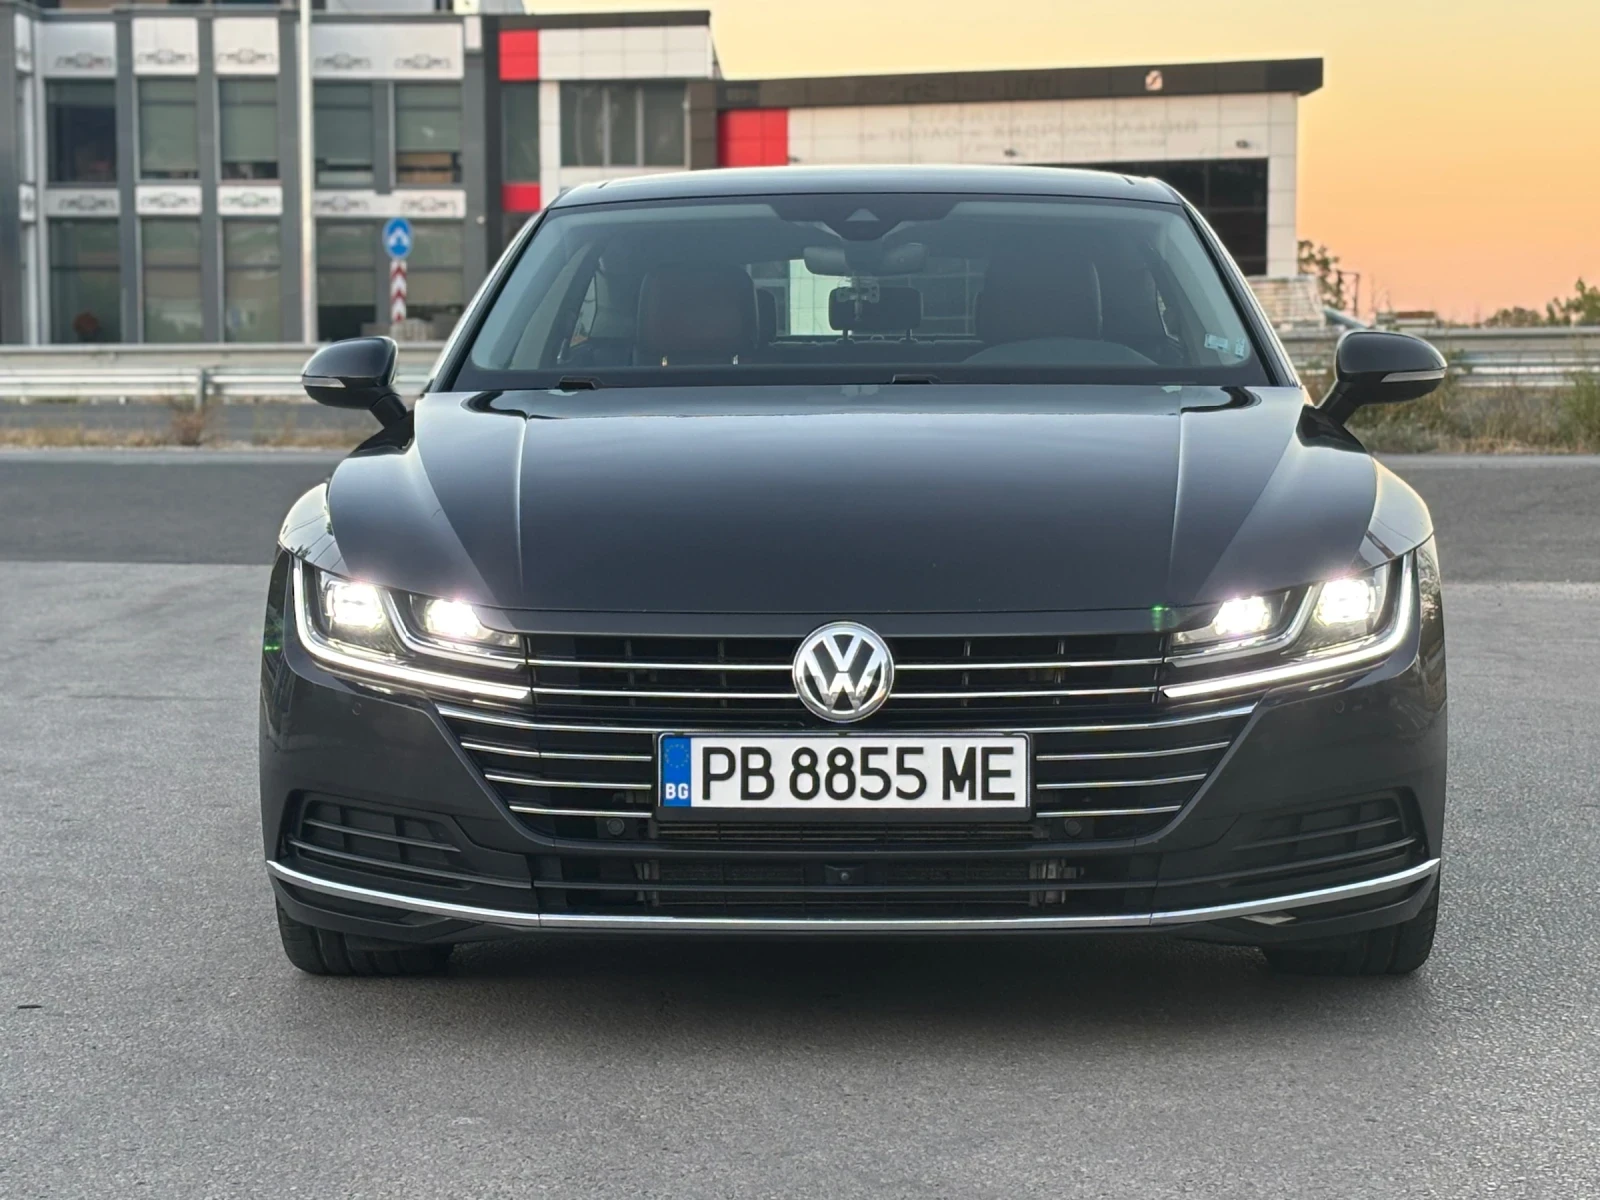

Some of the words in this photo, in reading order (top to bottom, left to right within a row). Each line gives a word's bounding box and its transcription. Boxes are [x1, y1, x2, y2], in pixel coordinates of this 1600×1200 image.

[800, 630, 888, 716] VW
[665, 783, 689, 800] BG
[702, 746, 775, 800] PB
[789, 747, 927, 801] 8855
[942, 746, 1015, 801] ME
